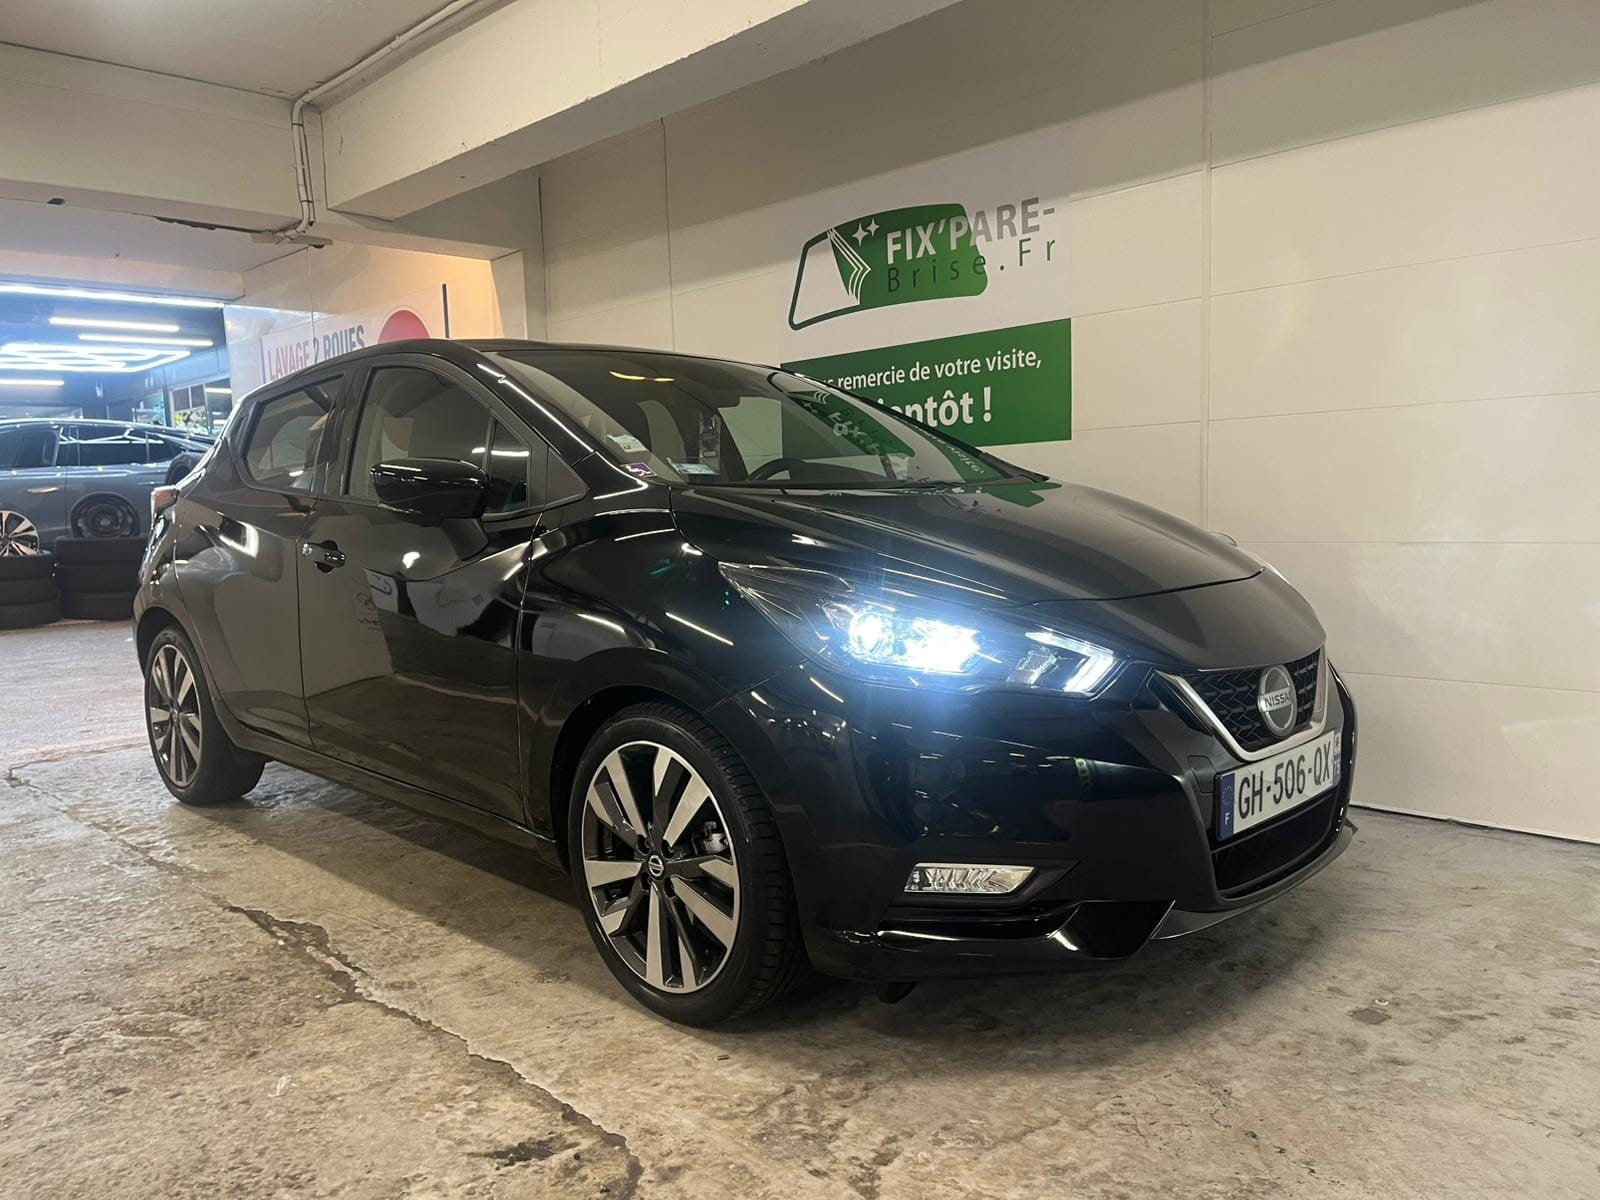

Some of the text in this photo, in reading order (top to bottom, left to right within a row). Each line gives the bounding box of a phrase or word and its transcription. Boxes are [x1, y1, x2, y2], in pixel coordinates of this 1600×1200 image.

[268, 340, 310, 381] LAVAGE
[837, 366, 906, 390] remercie
[909, 361, 931, 382] de
[934, 356, 981, 378] votre
[985, 348, 1042, 372] visite,
[982, 386, 993, 423] !
[1238, 741, 1331, 820] GH-506-QX
